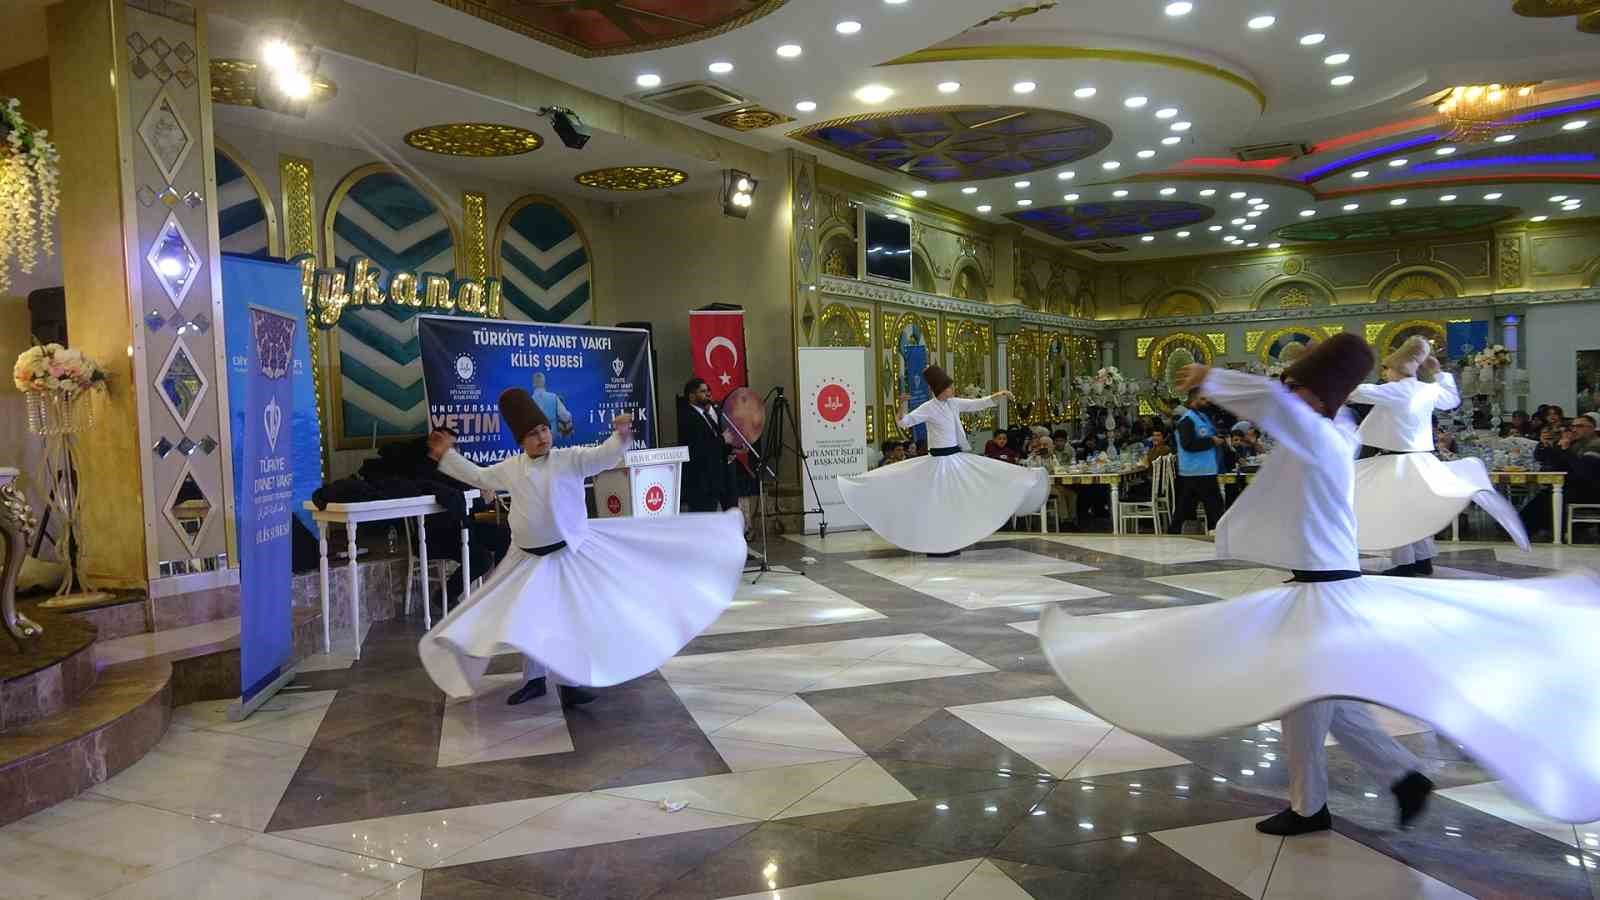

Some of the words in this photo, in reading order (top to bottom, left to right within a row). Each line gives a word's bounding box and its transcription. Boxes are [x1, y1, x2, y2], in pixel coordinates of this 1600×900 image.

[472, 328, 525, 347] TÜRKİYE
[529, 330, 577, 349] DİYANET
[580, 337, 611, 350] VAKFI
[511, 350, 540, 368] KİLİS
[544, 352, 583, 371] ŞUBESİ
[431, 404, 499, 413] UNUTURSAN
